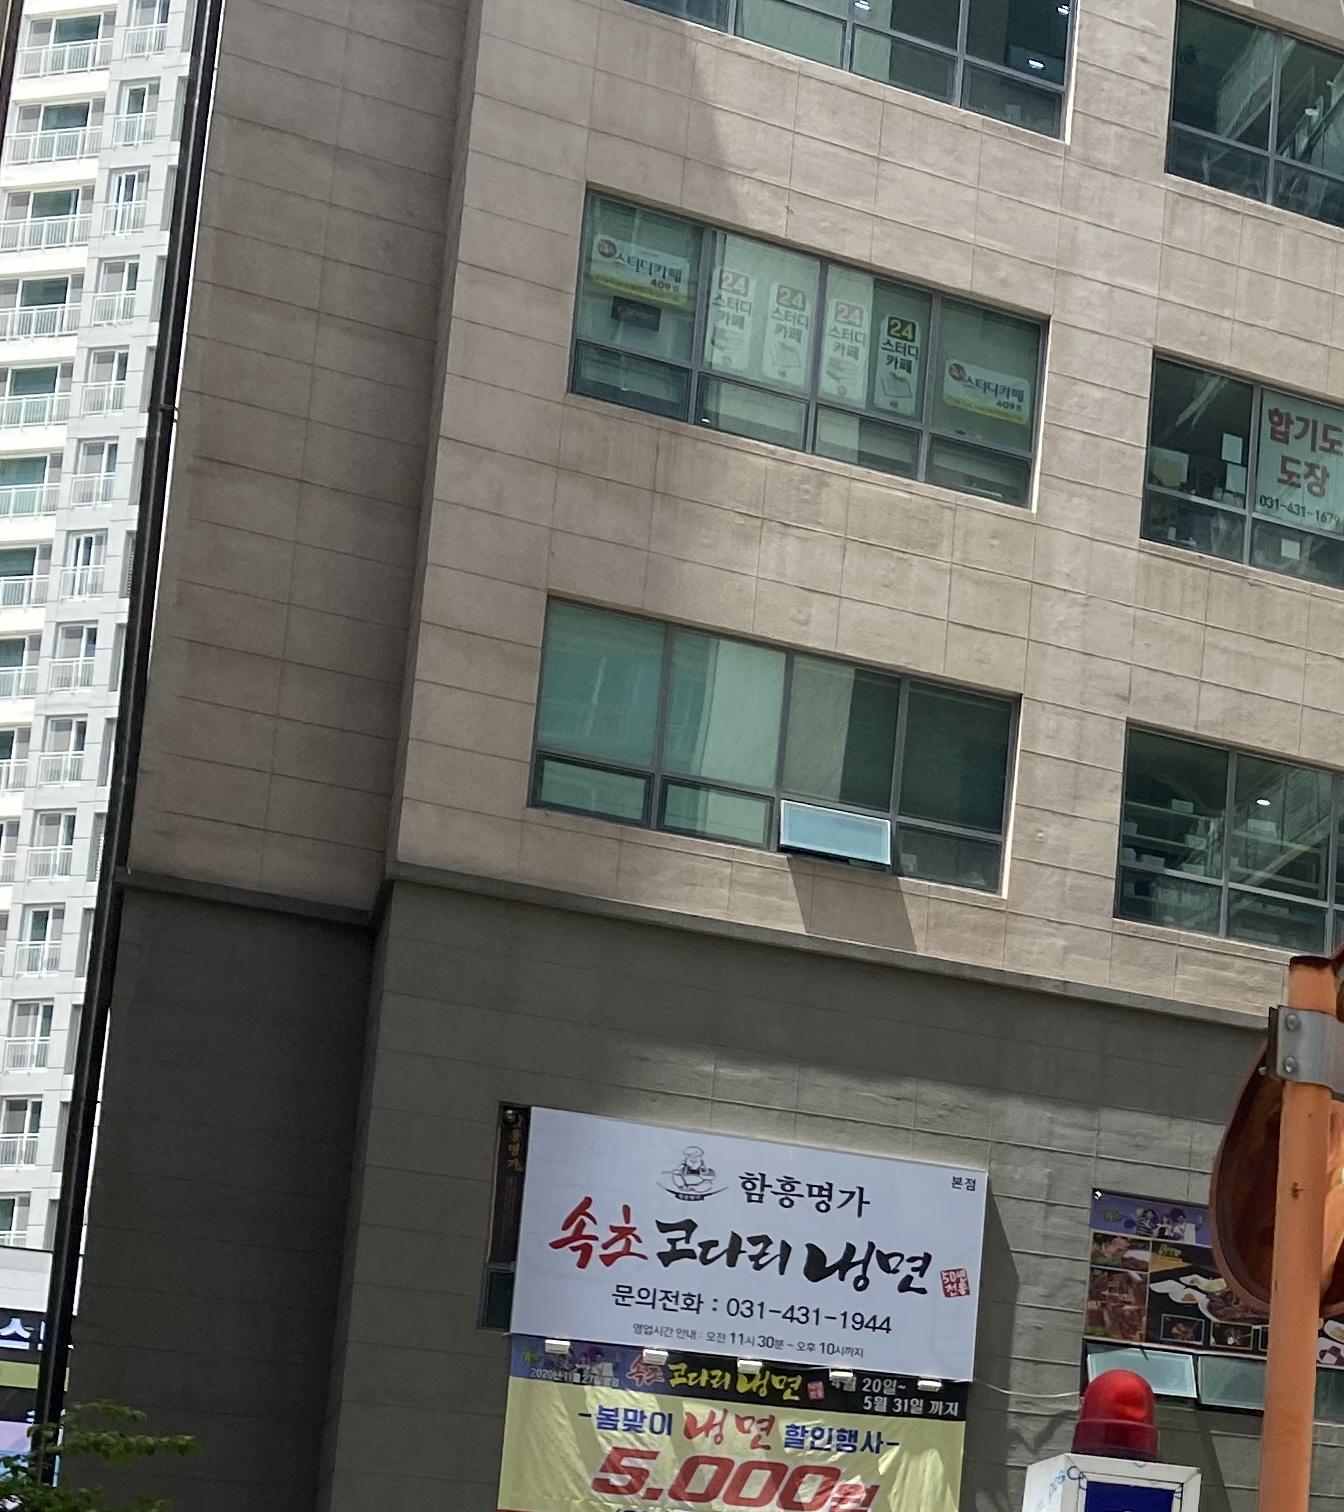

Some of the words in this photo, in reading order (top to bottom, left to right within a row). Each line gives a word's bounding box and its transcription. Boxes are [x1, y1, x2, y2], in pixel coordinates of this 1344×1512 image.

[889, 318, 915, 341] 24
[881, 340, 919, 360] 스터디
[886, 355, 913, 374] 카페
[1267, 406, 1344, 458] 합기도
[1277, 454, 1331, 499] 도장
[1258, 493, 1342, 529] 031-431-1679
[738, 1171, 871, 1218] 함흥명가
[951, 1175, 977, 1192] 본점
[548, 1196, 649, 1269] 속초
[654, 1218, 793, 1276] 코다리
[802, 1240, 933, 1297] 냉면
[611, 1283, 704, 1315] 문의전화
[726, 1297, 893, 1335] 031-431-1944
[632, 1322, 674, 1339] 영업시간
[705, 1331, 727, 1344] 오전
[796, 1340, 816, 1353] 오후
[667, 1361, 731, 1391] 코다리
[736, 1366, 802, 1401] 냉면
[863, 1395, 888, 1413] 5월
[893, 1398, 924, 1415] 31일
[928, 1400, 959, 1417] 까지
[684, 1407, 775, 1451] 냉면
